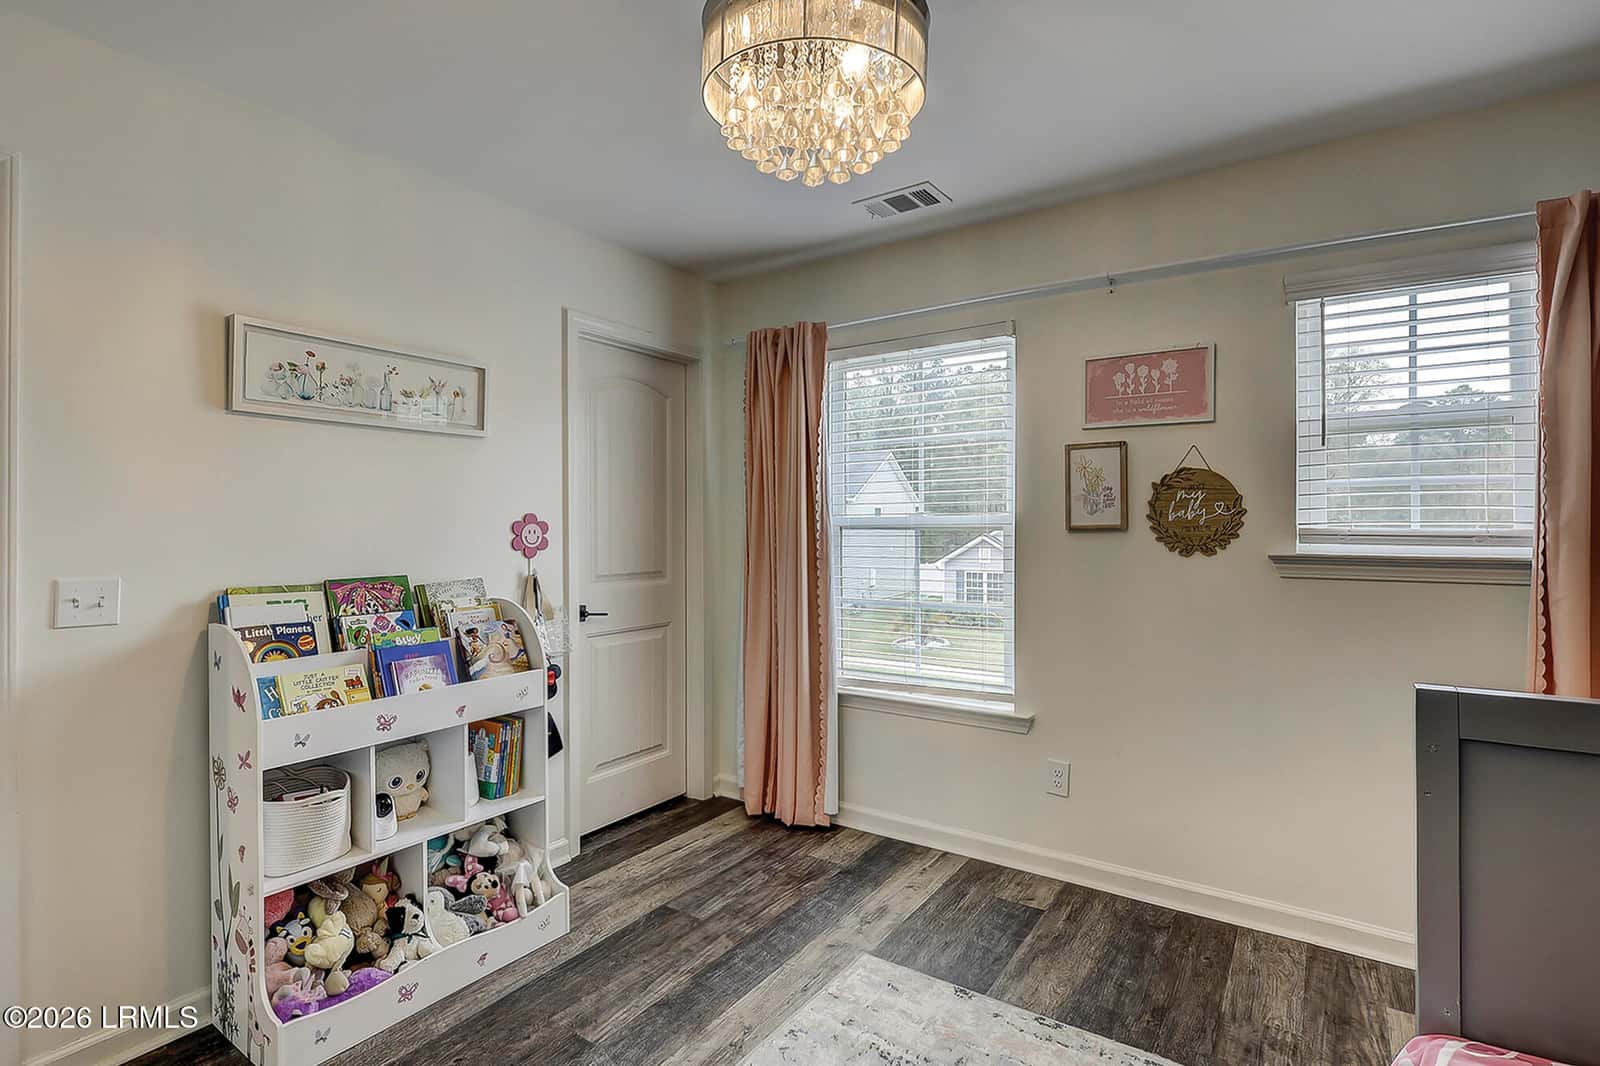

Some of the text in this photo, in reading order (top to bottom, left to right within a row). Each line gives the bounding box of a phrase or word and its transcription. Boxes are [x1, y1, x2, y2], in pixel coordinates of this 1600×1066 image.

[1176, 490, 1207, 509] my
[1168, 499, 1206, 525] baby
[276, 625, 312, 635] Planets
[304, 672, 318, 680] JUST
[293, 678, 313, 687] LITTLE
[300, 681, 335, 690] COLLECTION
